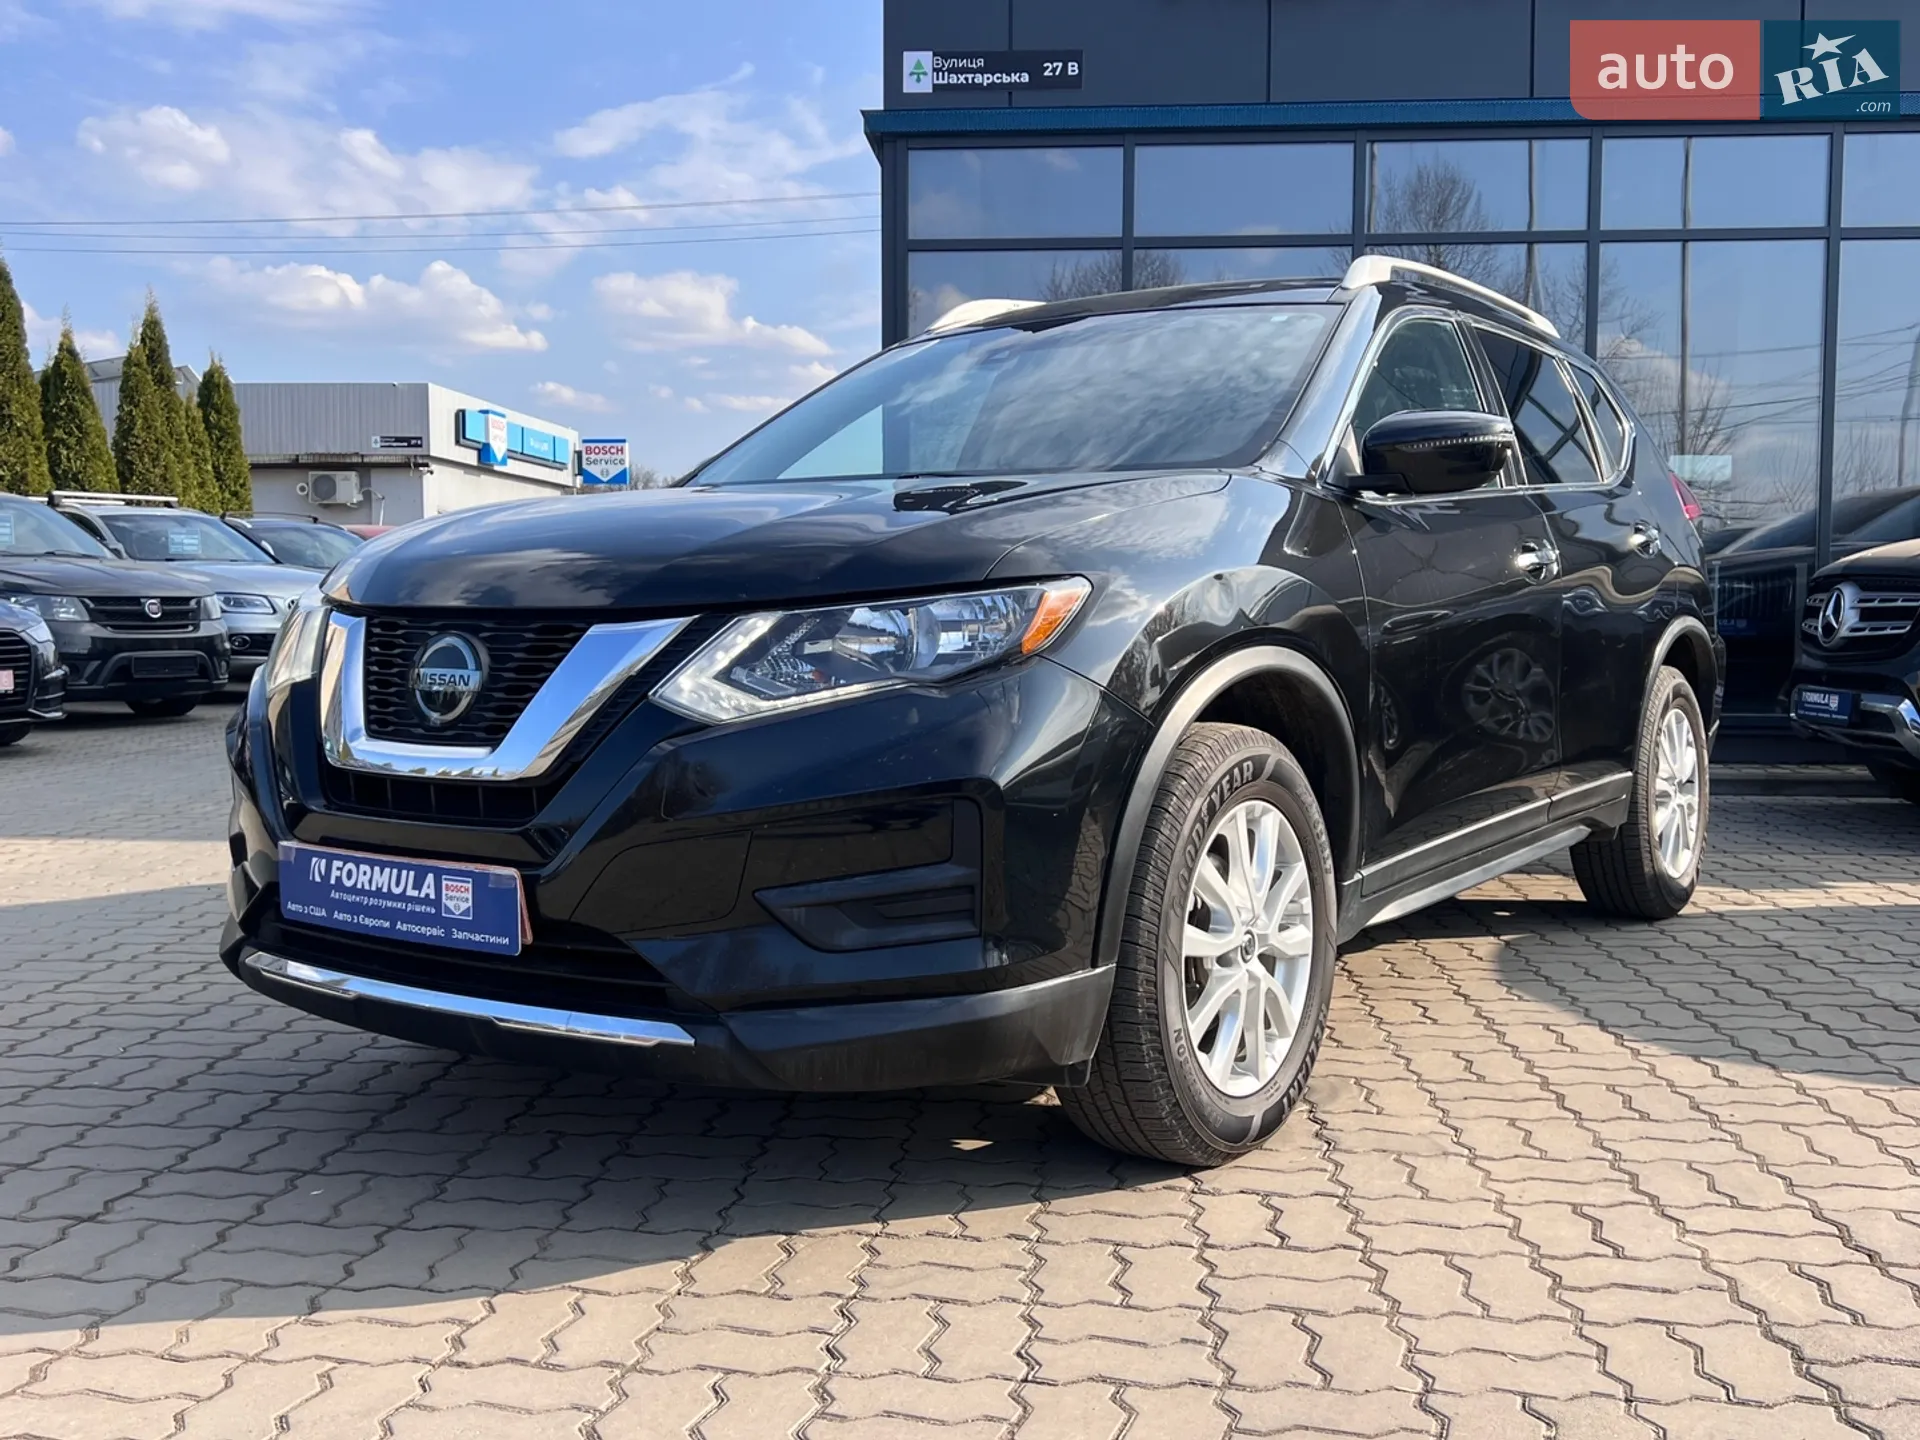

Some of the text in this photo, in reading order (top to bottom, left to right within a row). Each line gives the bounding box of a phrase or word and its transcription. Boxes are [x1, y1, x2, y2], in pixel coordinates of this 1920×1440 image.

[933, 56, 985, 70] Вулиця
[1043, 63, 1063, 76] 27
[933, 71, 1030, 86] Шахтарська
[585, 445, 624, 455] BOSCH
[585, 456, 626, 466] Service
[329, 859, 436, 899] FORMULA
[444, 882, 470, 894] BOSCH
[329, 889, 436, 914] Автоцентр розумних рішень
[444, 893, 470, 904] Service
[286, 901, 303, 913] Авто
[308, 905, 327, 917] США
[333, 910, 352, 922] Авто
[359, 914, 391, 928] Європи
[395, 920, 446, 937] Автосервіс
[451, 928, 510, 945] Запчастини
